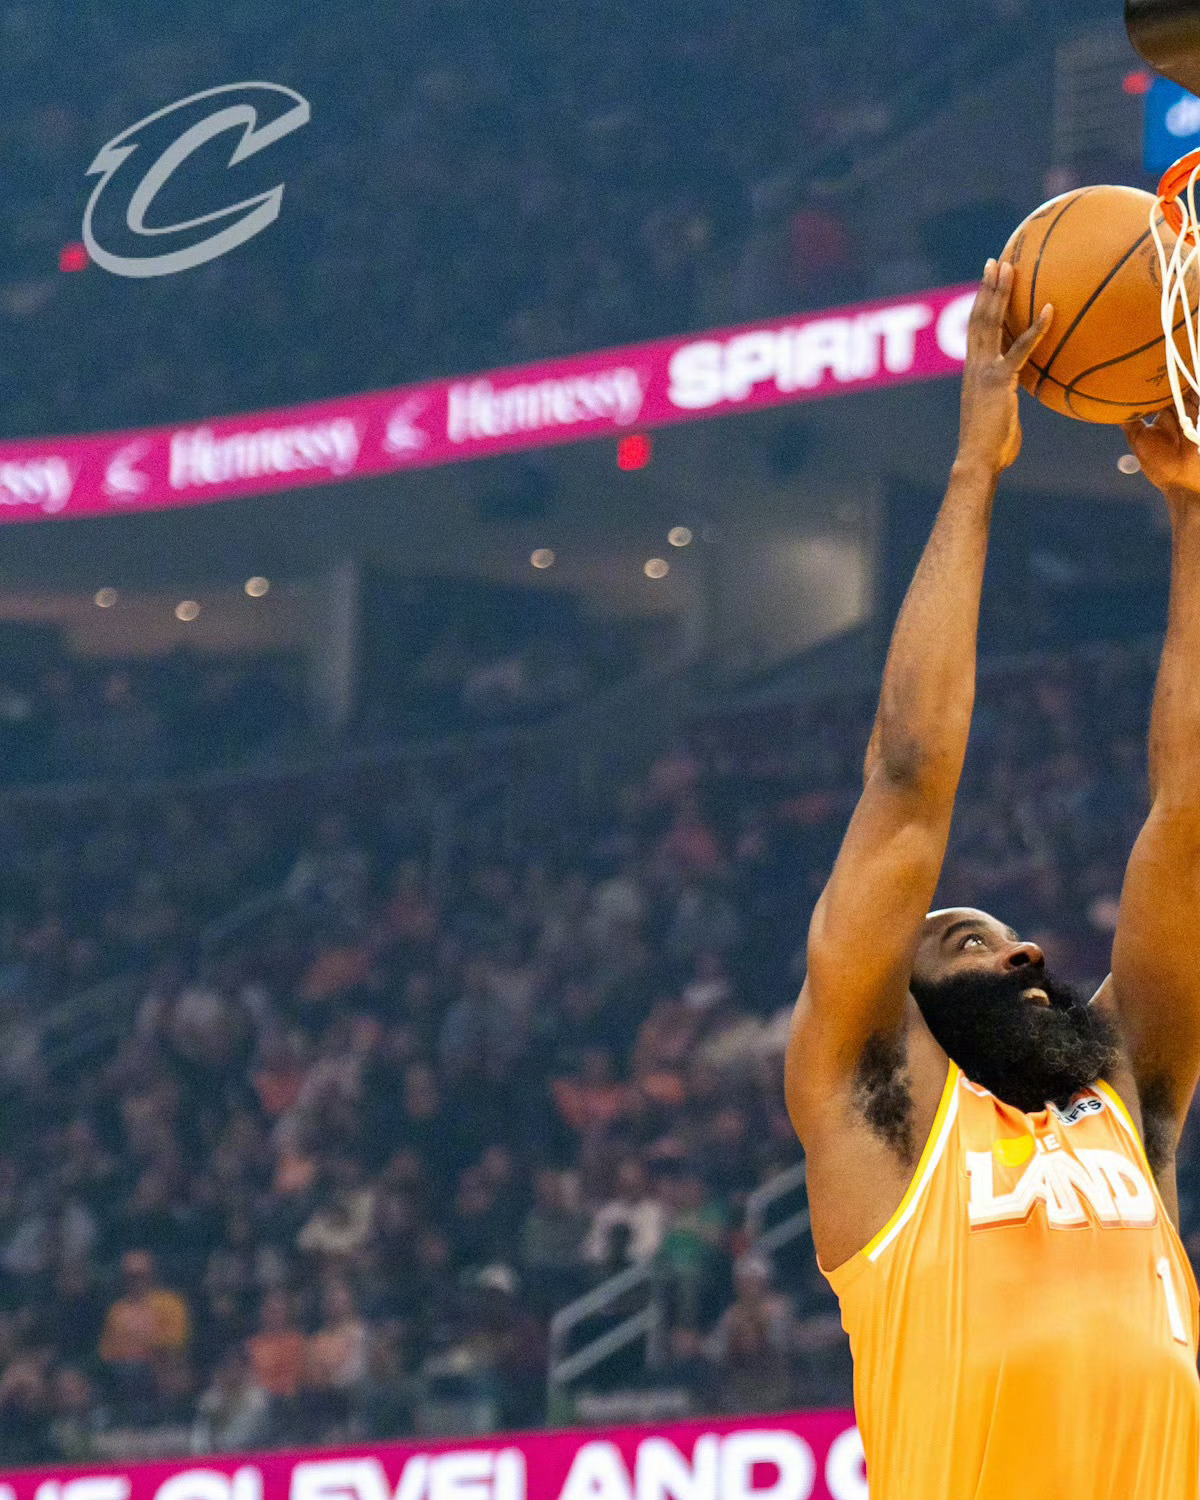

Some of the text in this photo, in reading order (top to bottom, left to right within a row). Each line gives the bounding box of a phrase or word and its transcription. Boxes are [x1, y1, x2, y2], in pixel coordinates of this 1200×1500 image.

[169, 416, 364, 489] Hennessy
[447, 367, 648, 443] Hennessy
[668, 303, 933, 409] SPIRIT
[965, 1147, 1158, 1231] LAND
[1156, 1256, 1188, 1346] 1
